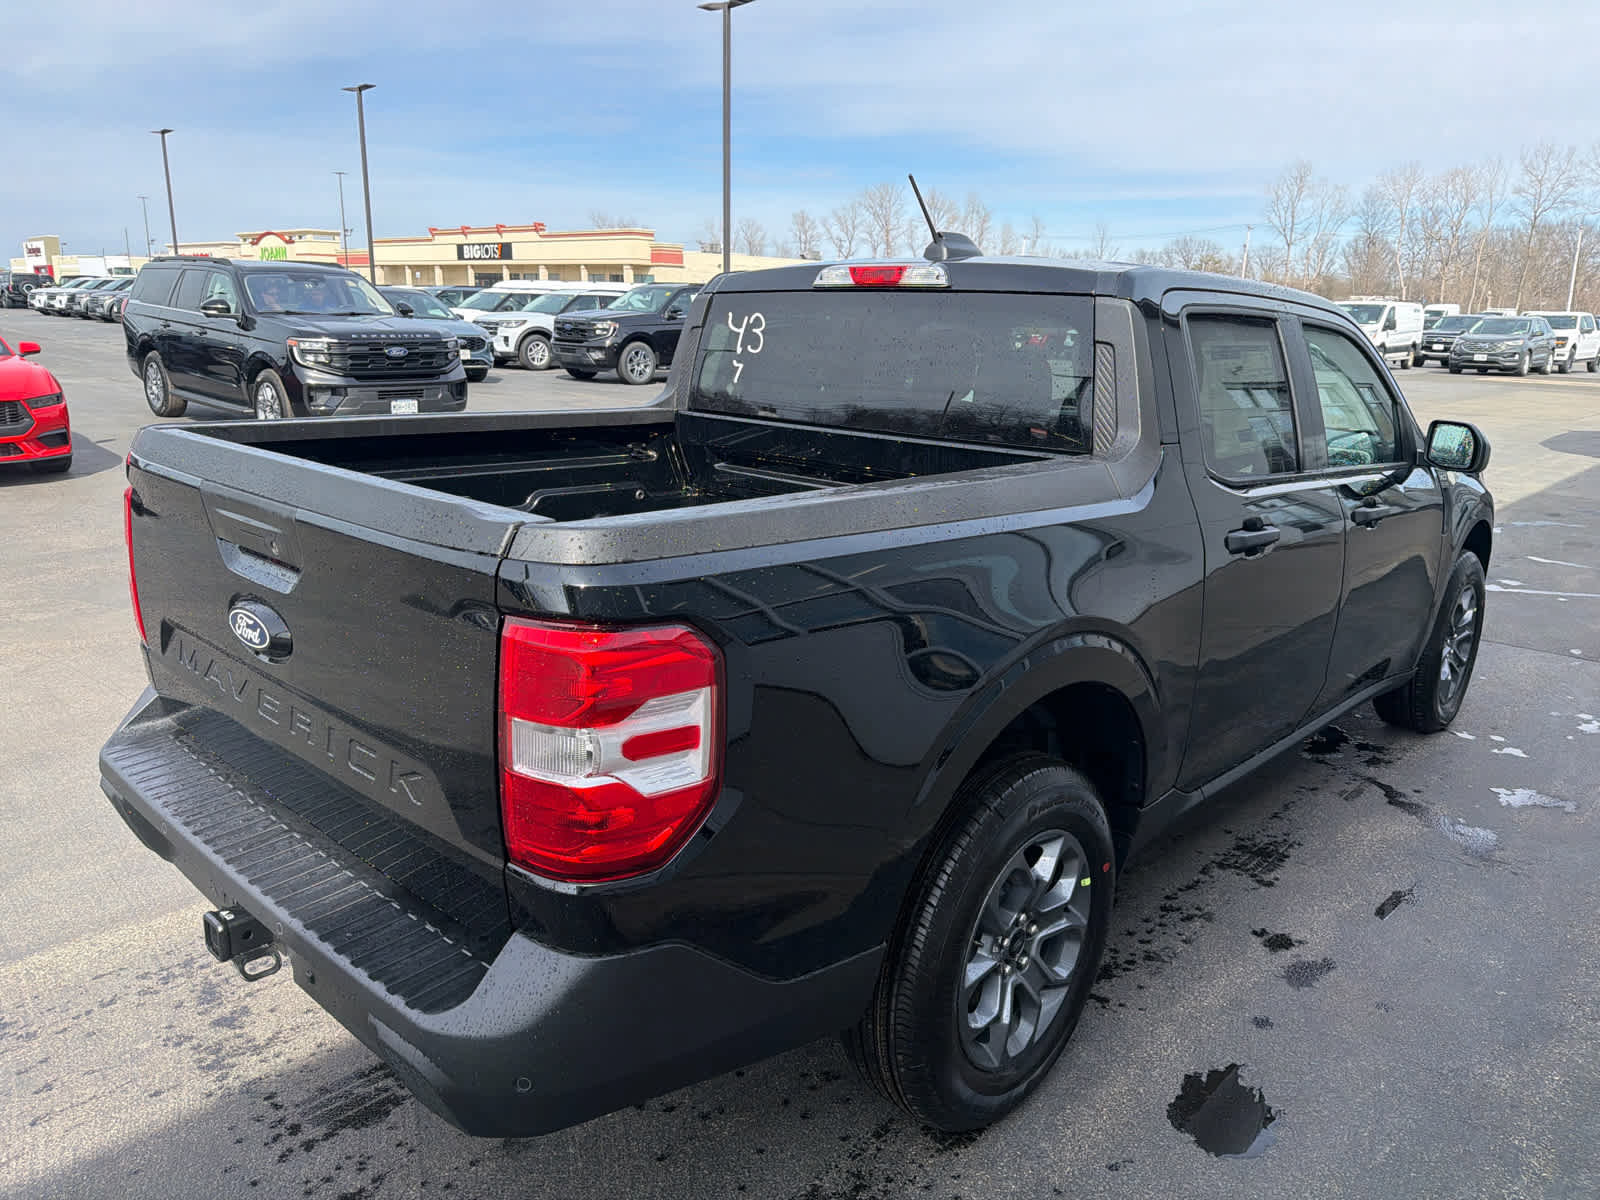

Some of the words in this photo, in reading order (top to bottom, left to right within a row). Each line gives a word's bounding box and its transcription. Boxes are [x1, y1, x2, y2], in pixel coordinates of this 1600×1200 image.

[260, 247, 288, 261] JOANN
[727, 311, 766, 354] 43
[234, 612, 262, 645] Ford
[177, 638, 425, 806] MAVERICK
